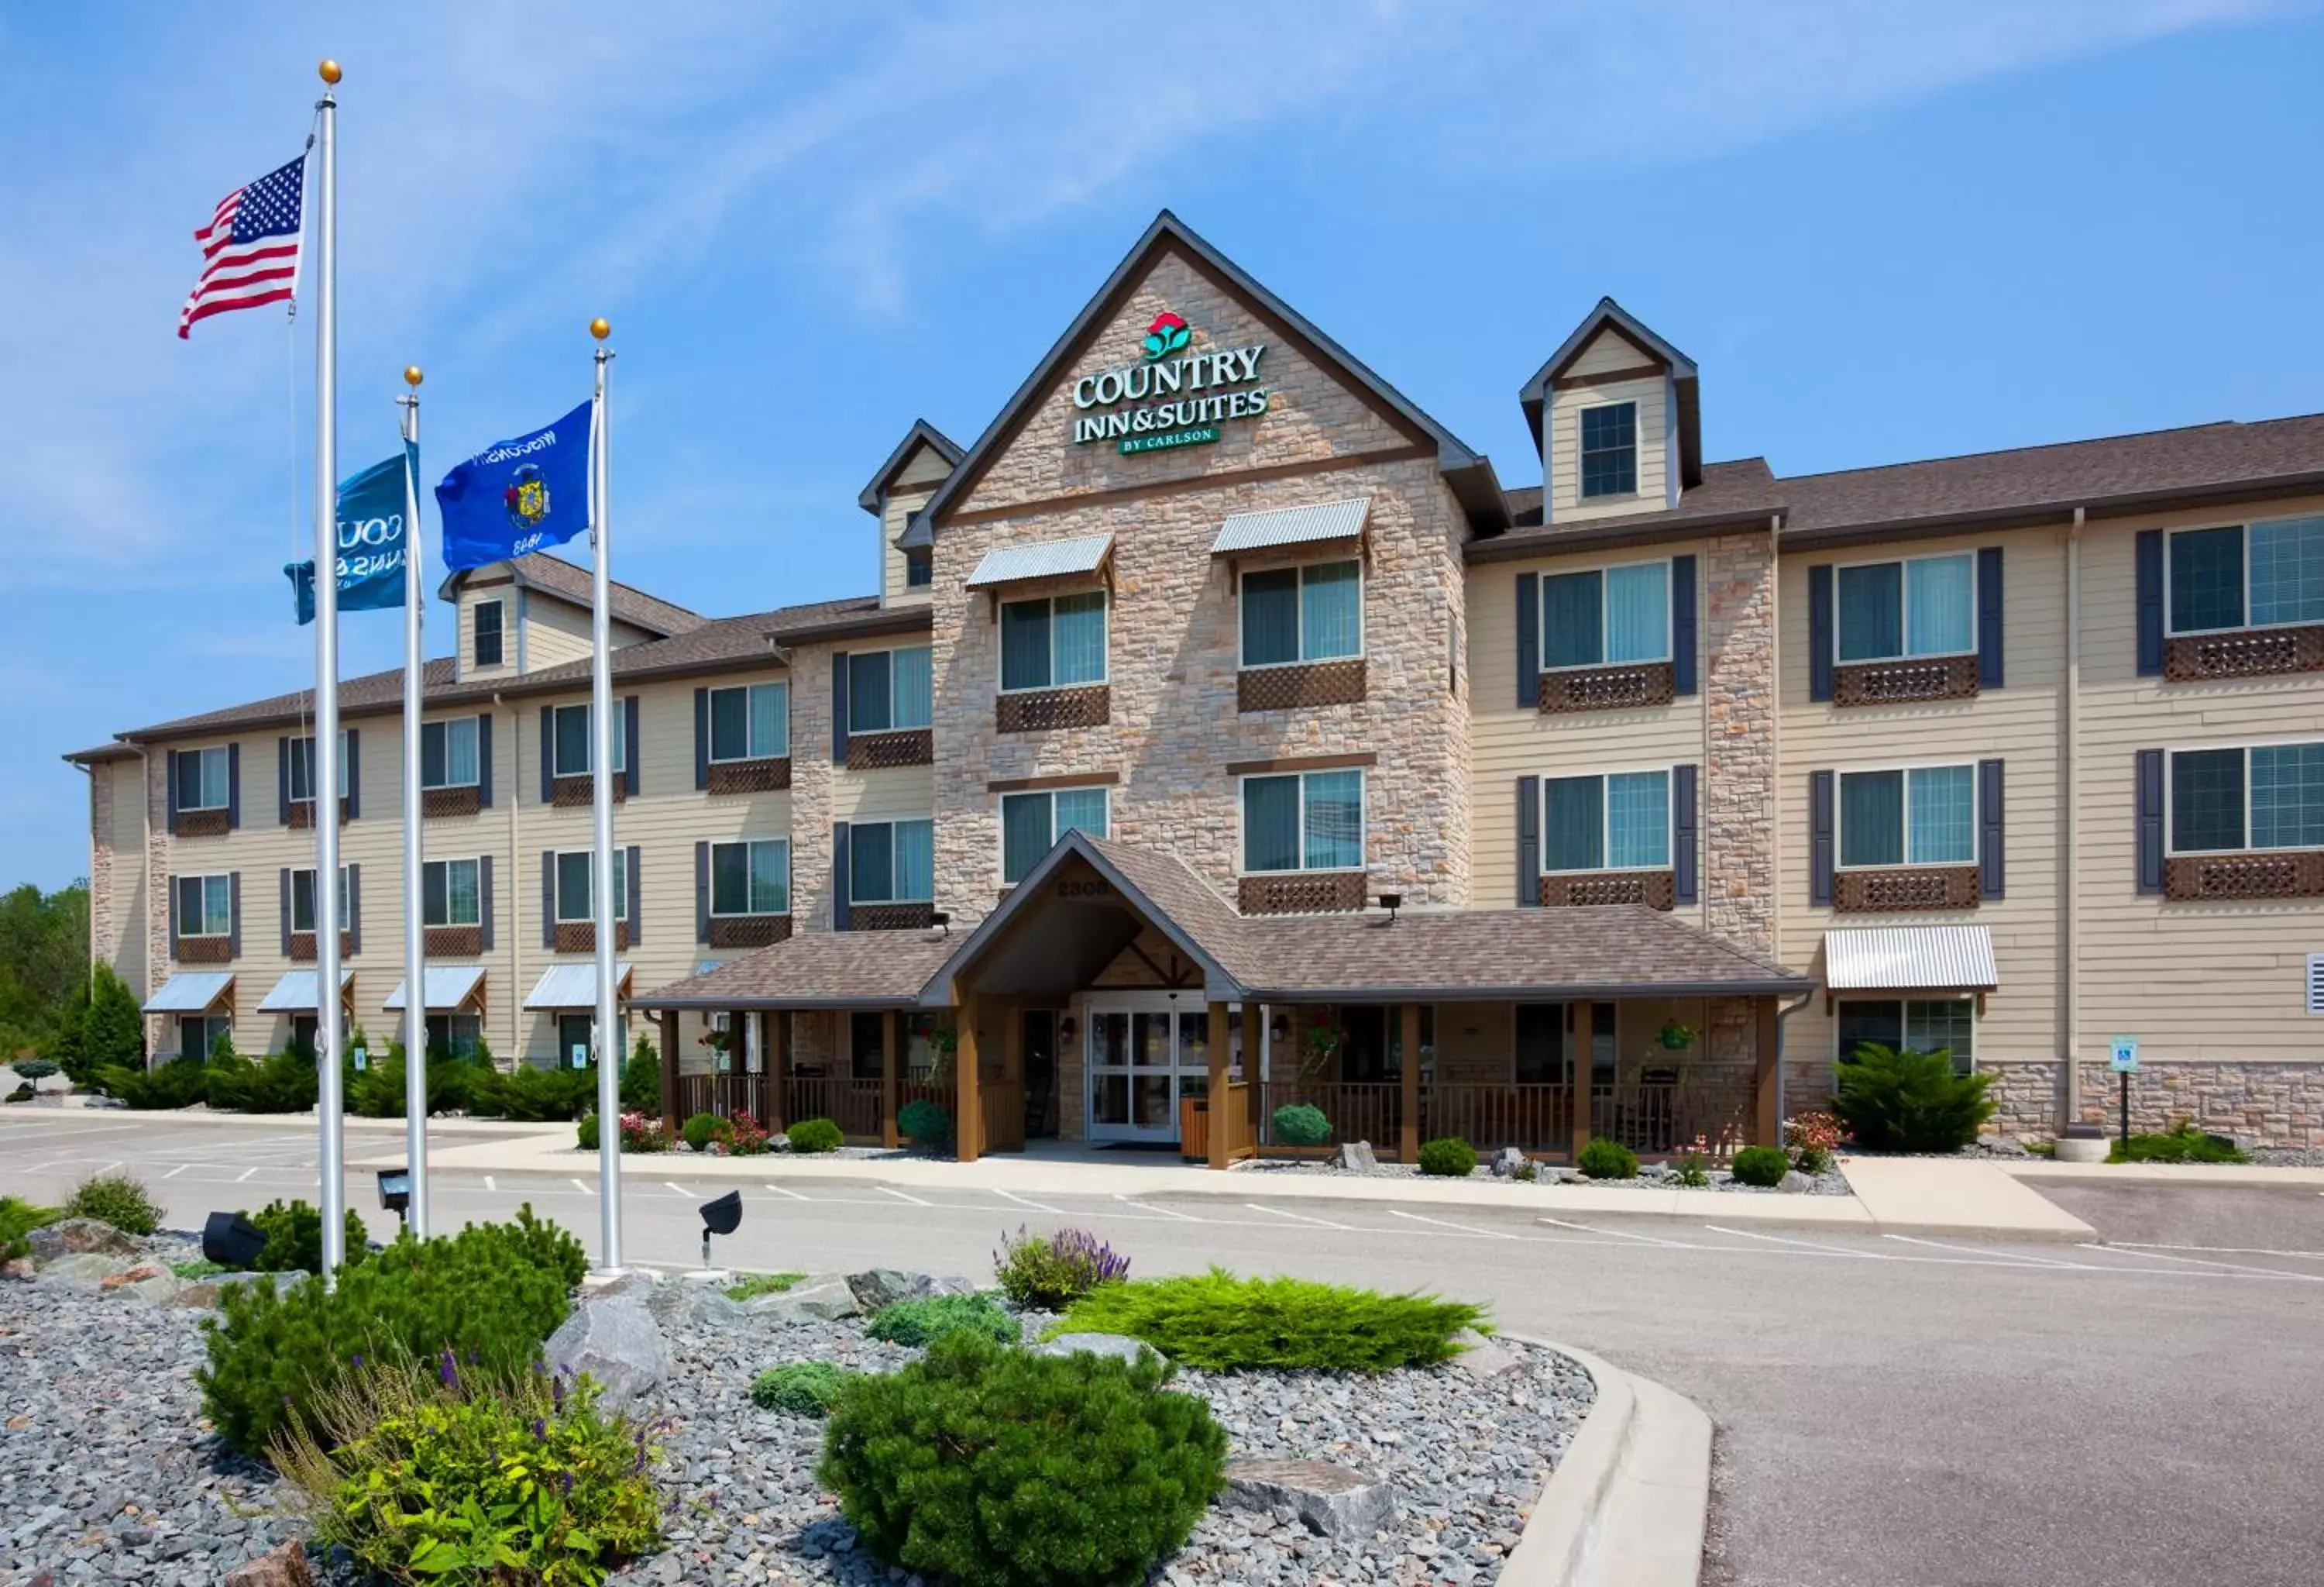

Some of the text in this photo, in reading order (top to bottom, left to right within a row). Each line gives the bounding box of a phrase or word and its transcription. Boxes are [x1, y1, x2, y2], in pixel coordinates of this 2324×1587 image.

[1073, 345, 1267, 409] COUNTRY
[1124, 429, 1212, 451] BY CARLSON
